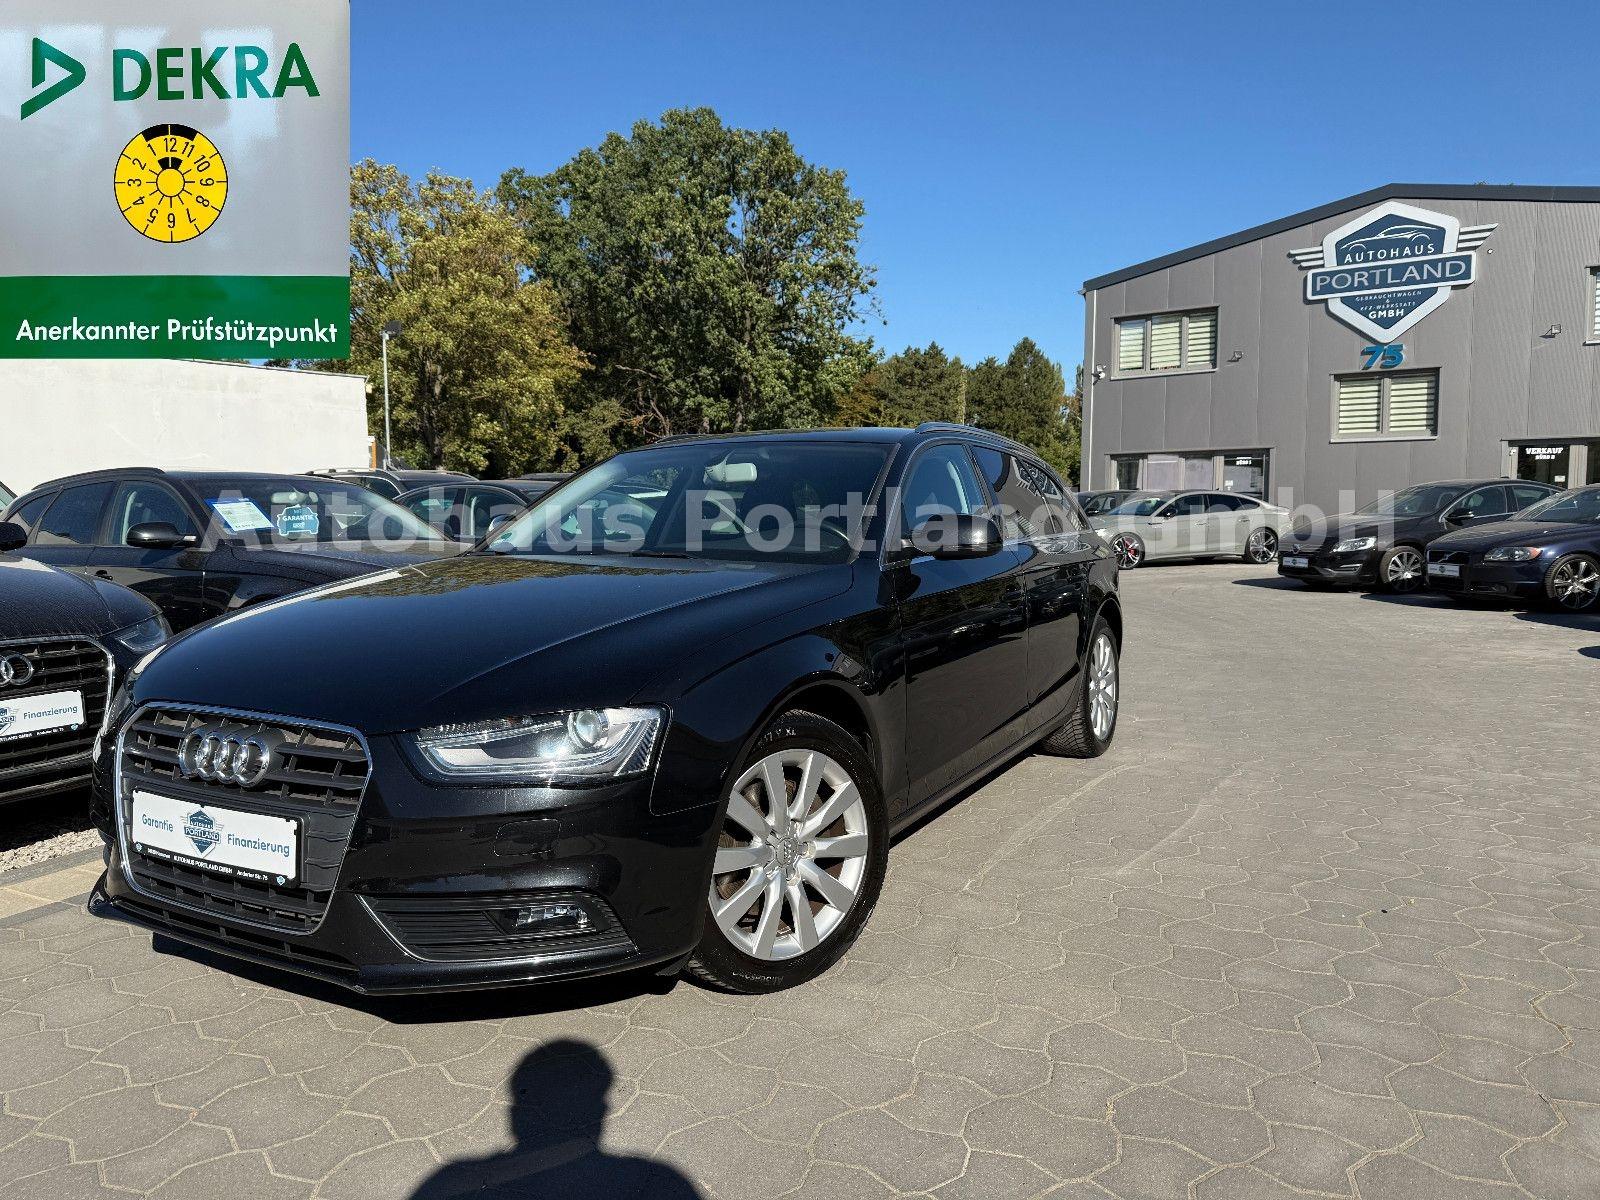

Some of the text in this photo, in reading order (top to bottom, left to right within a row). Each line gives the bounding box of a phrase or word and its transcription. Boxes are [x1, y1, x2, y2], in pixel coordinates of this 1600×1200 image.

[1344, 243, 1435, 264] AUTOHAUS
[1316, 260, 1466, 292] PORTLAND
[1355, 290, 1422, 302] GEBRAUCHTWAGEN
[1368, 308, 1404, 319] GMBH
[1361, 344, 1405, 370] 75
[23, 706, 78, 719] Finanzierung
[142, 813, 174, 832] Garantie
[185, 827, 219, 841] PORTLAND
[228, 834, 290, 857] Finanzierung
